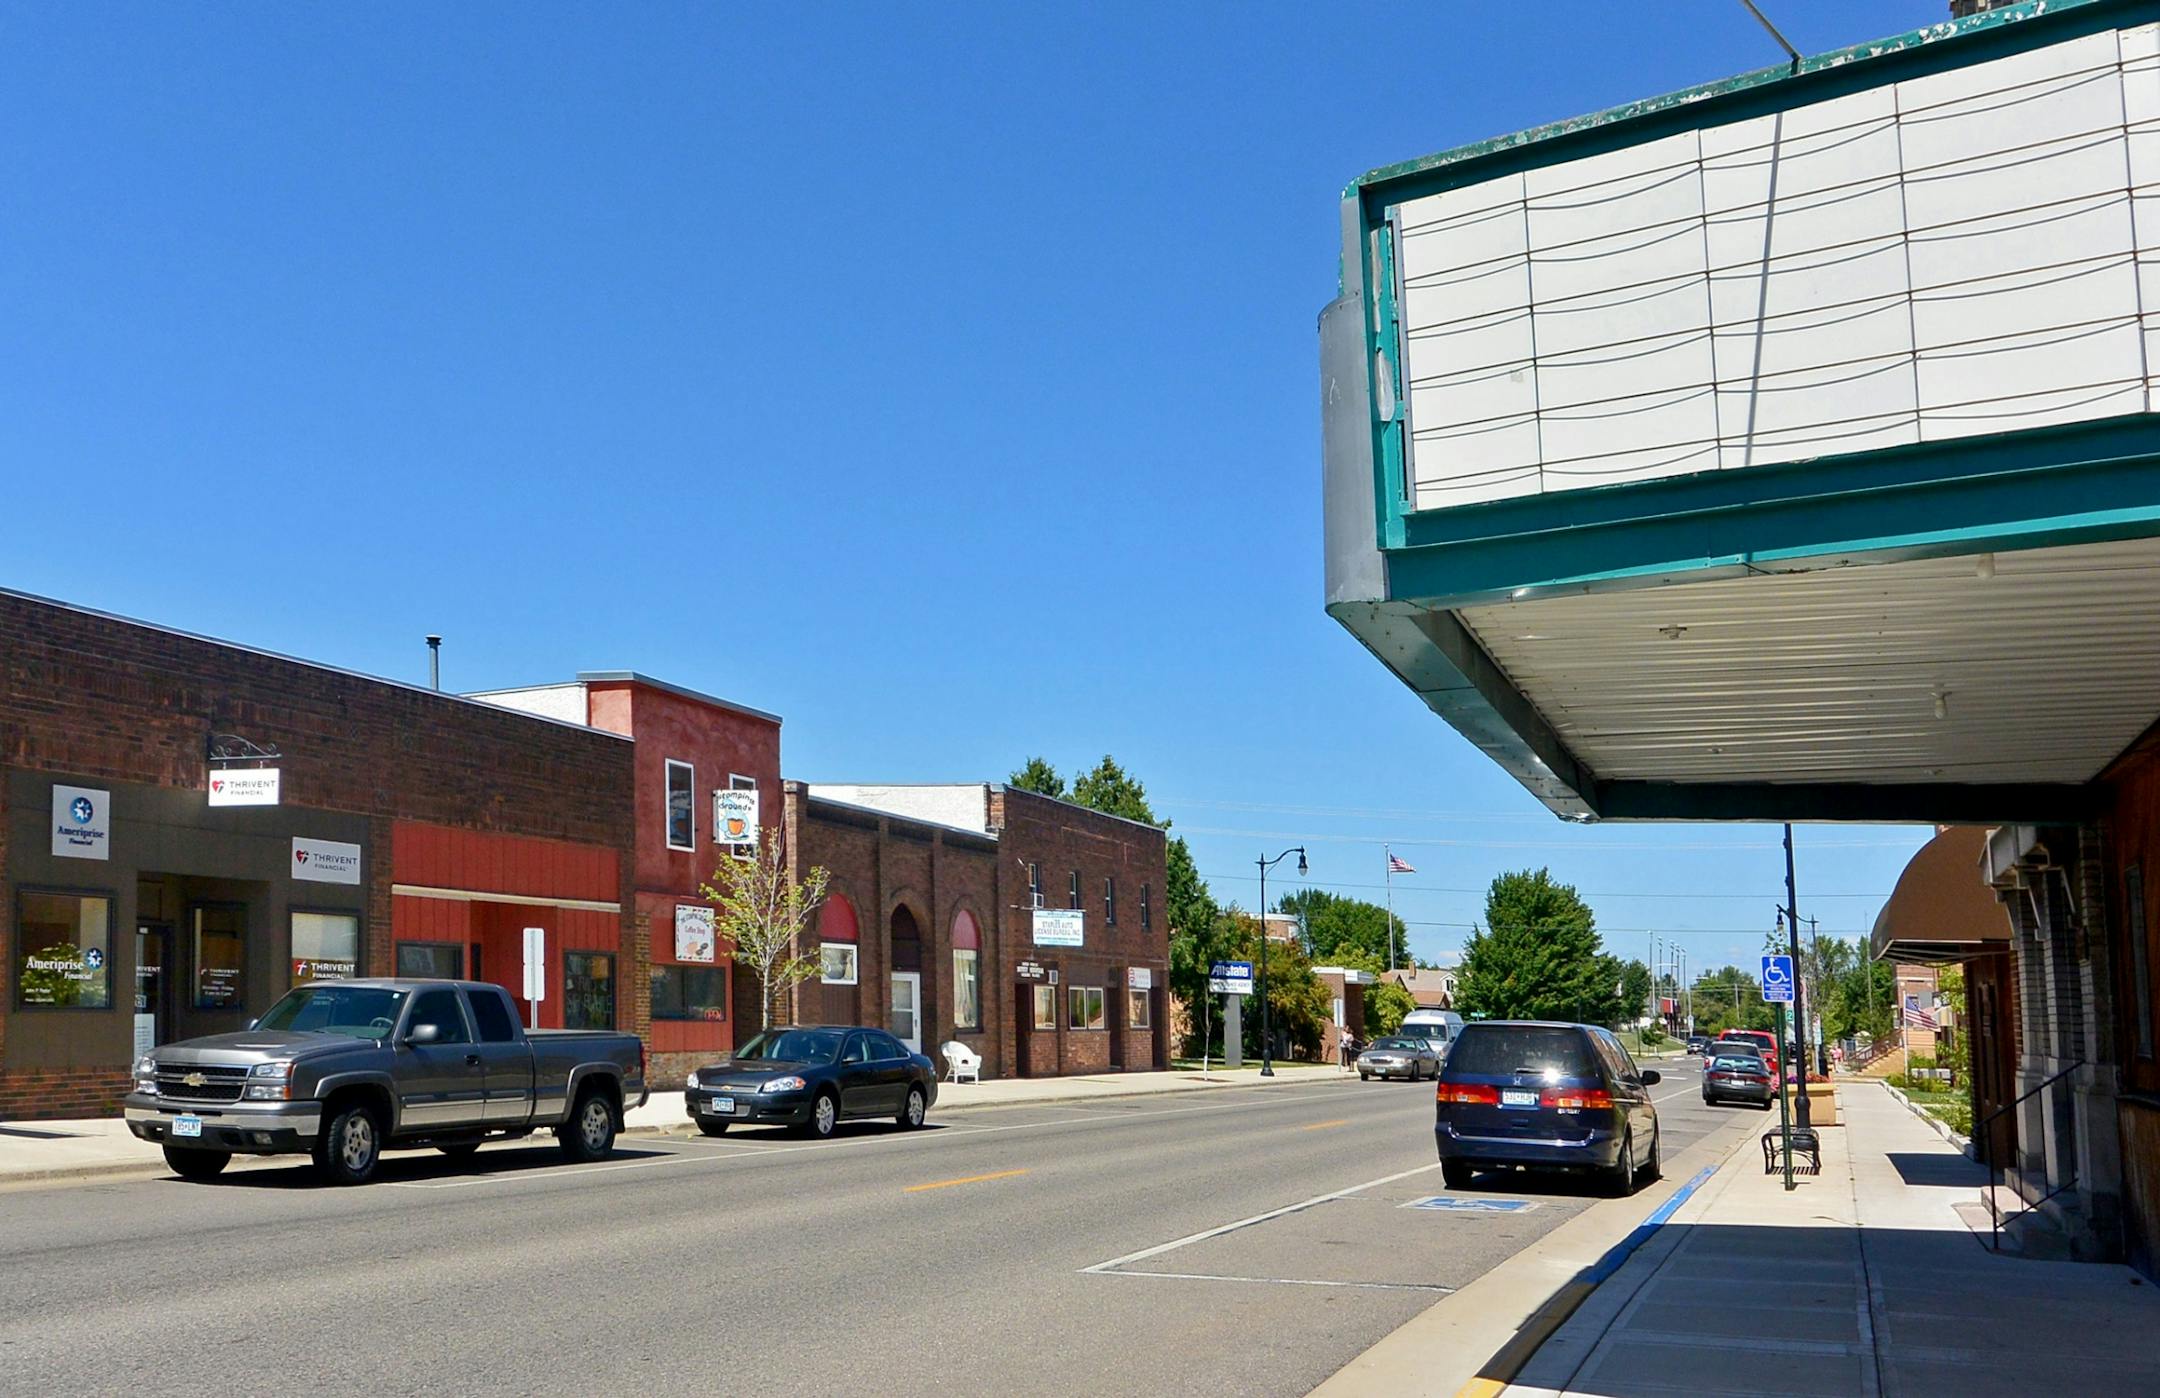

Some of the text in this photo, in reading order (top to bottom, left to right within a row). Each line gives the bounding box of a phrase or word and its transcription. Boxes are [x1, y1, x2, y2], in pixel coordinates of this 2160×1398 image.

[229, 780, 276, 788] THRIVENT
[57, 826, 105, 839] Ameriprise
[68, 838, 93, 846] Financial
[313, 853, 358, 865] THRIVENT
[314, 864, 346, 872] FINANCIAL
[26, 958, 84, 973] Ameriprise
[311, 962, 356, 972] THRIVENT
[64, 971, 93, 980] Financial
[1211, 964, 1249, 978] Allstate
[312, 972, 345, 980] FINANCIAL
